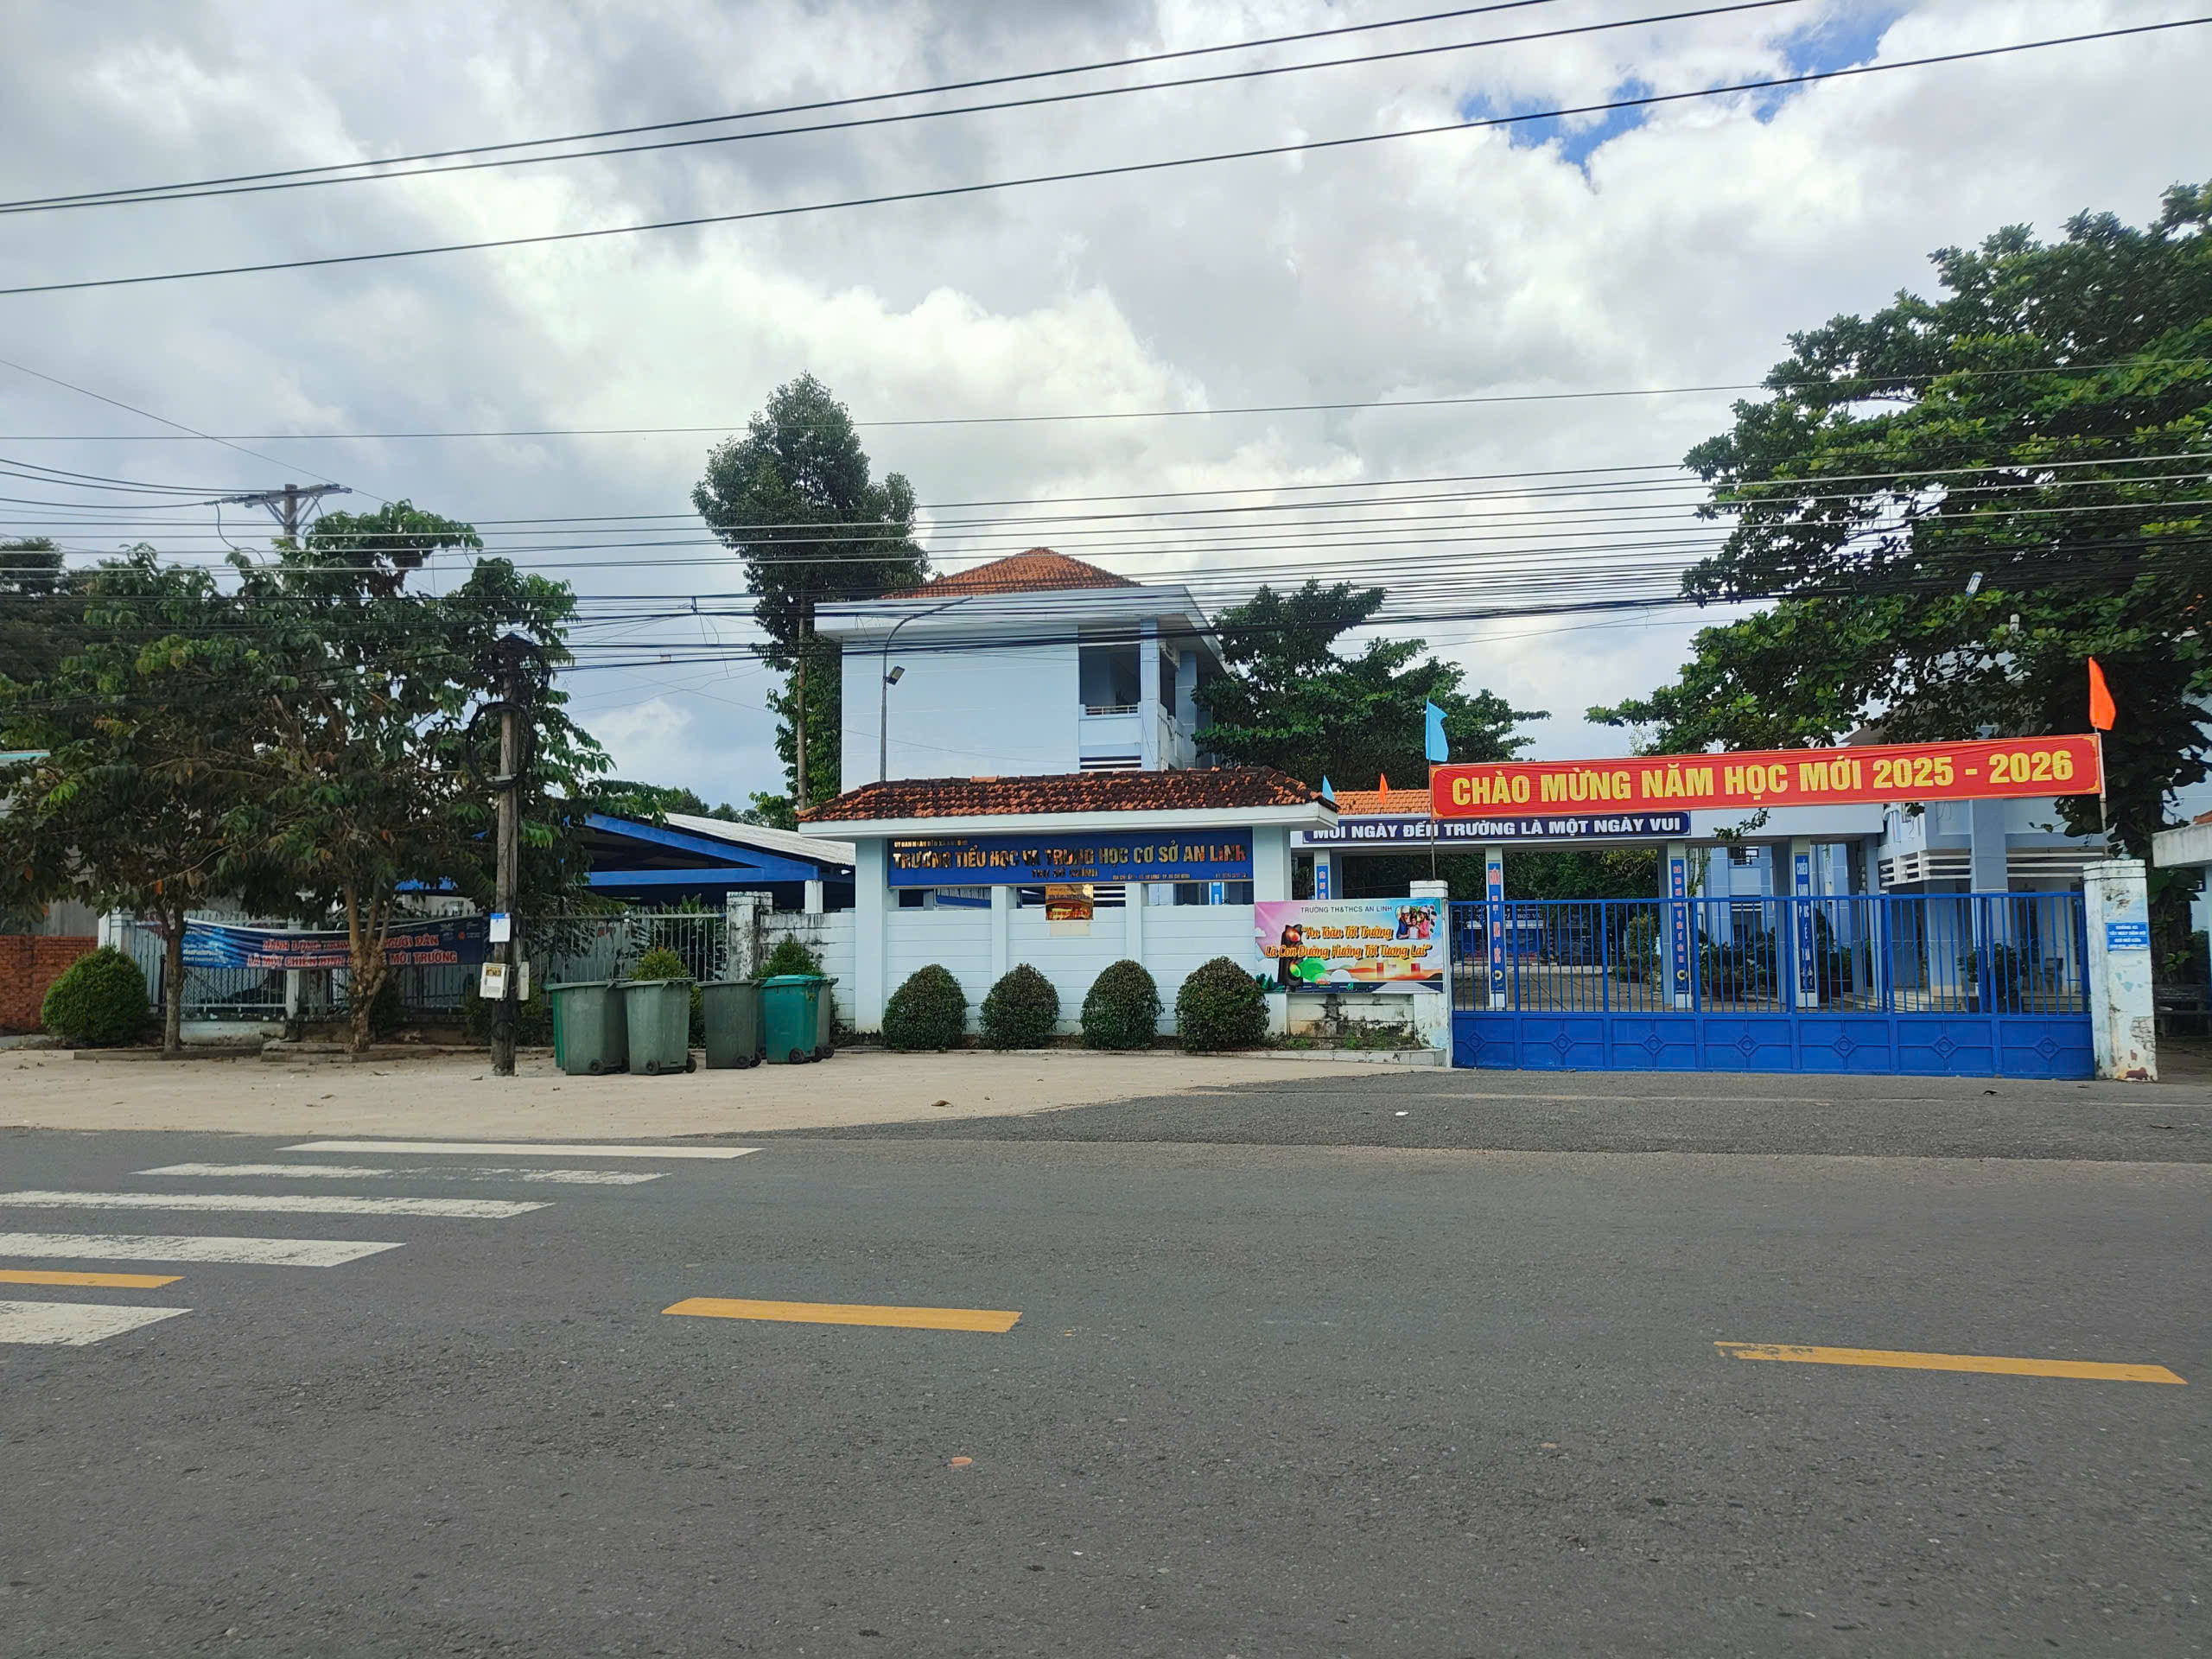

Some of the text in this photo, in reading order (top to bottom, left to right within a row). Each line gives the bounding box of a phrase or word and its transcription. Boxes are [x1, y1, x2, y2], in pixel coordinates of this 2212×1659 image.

[1452, 770, 1530, 805] CHÀO
[1540, 766, 1631, 802] MỪNG
[1642, 762, 1713, 798] NĂM
[1724, 765, 1788, 800] HỌC
[1799, 754, 1862, 791] MỚI
[1872, 756, 1954, 788] 2025
[1989, 750, 2074, 784] 2026
[1351, 822, 1397, 838] NGÀY
[1444, 820, 1516, 836] TRƯỜNG
[1521, 818, 1543, 835] LÀ
[1548, 818, 1588, 836] MỘT
[1594, 816, 1643, 833] NGÀY
[1649, 817, 1681, 832] VUI
[956, 844, 987, 868] TIỂU
[989, 849, 1019, 869] HỌC
[1045, 848, 1094, 865] TRUNG
[1098, 847, 1128, 868] HỌC
[1134, 845, 1154, 864] CƠ
[1159, 840, 1179, 863] SỞ
[1184, 845, 1205, 862] AN
[1300, 905, 1329, 913] TRƯỜNG
[1321, 926, 1342, 939] Toàn
[1360, 925, 1393, 940] Trường
[262, 953, 283, 969] MỘT
[390, 950, 410, 964] MÔI
[414, 949, 457, 964] TRƯỜNG
[1265, 945, 1277, 957] Là
[1279, 946, 1297, 957] Con
